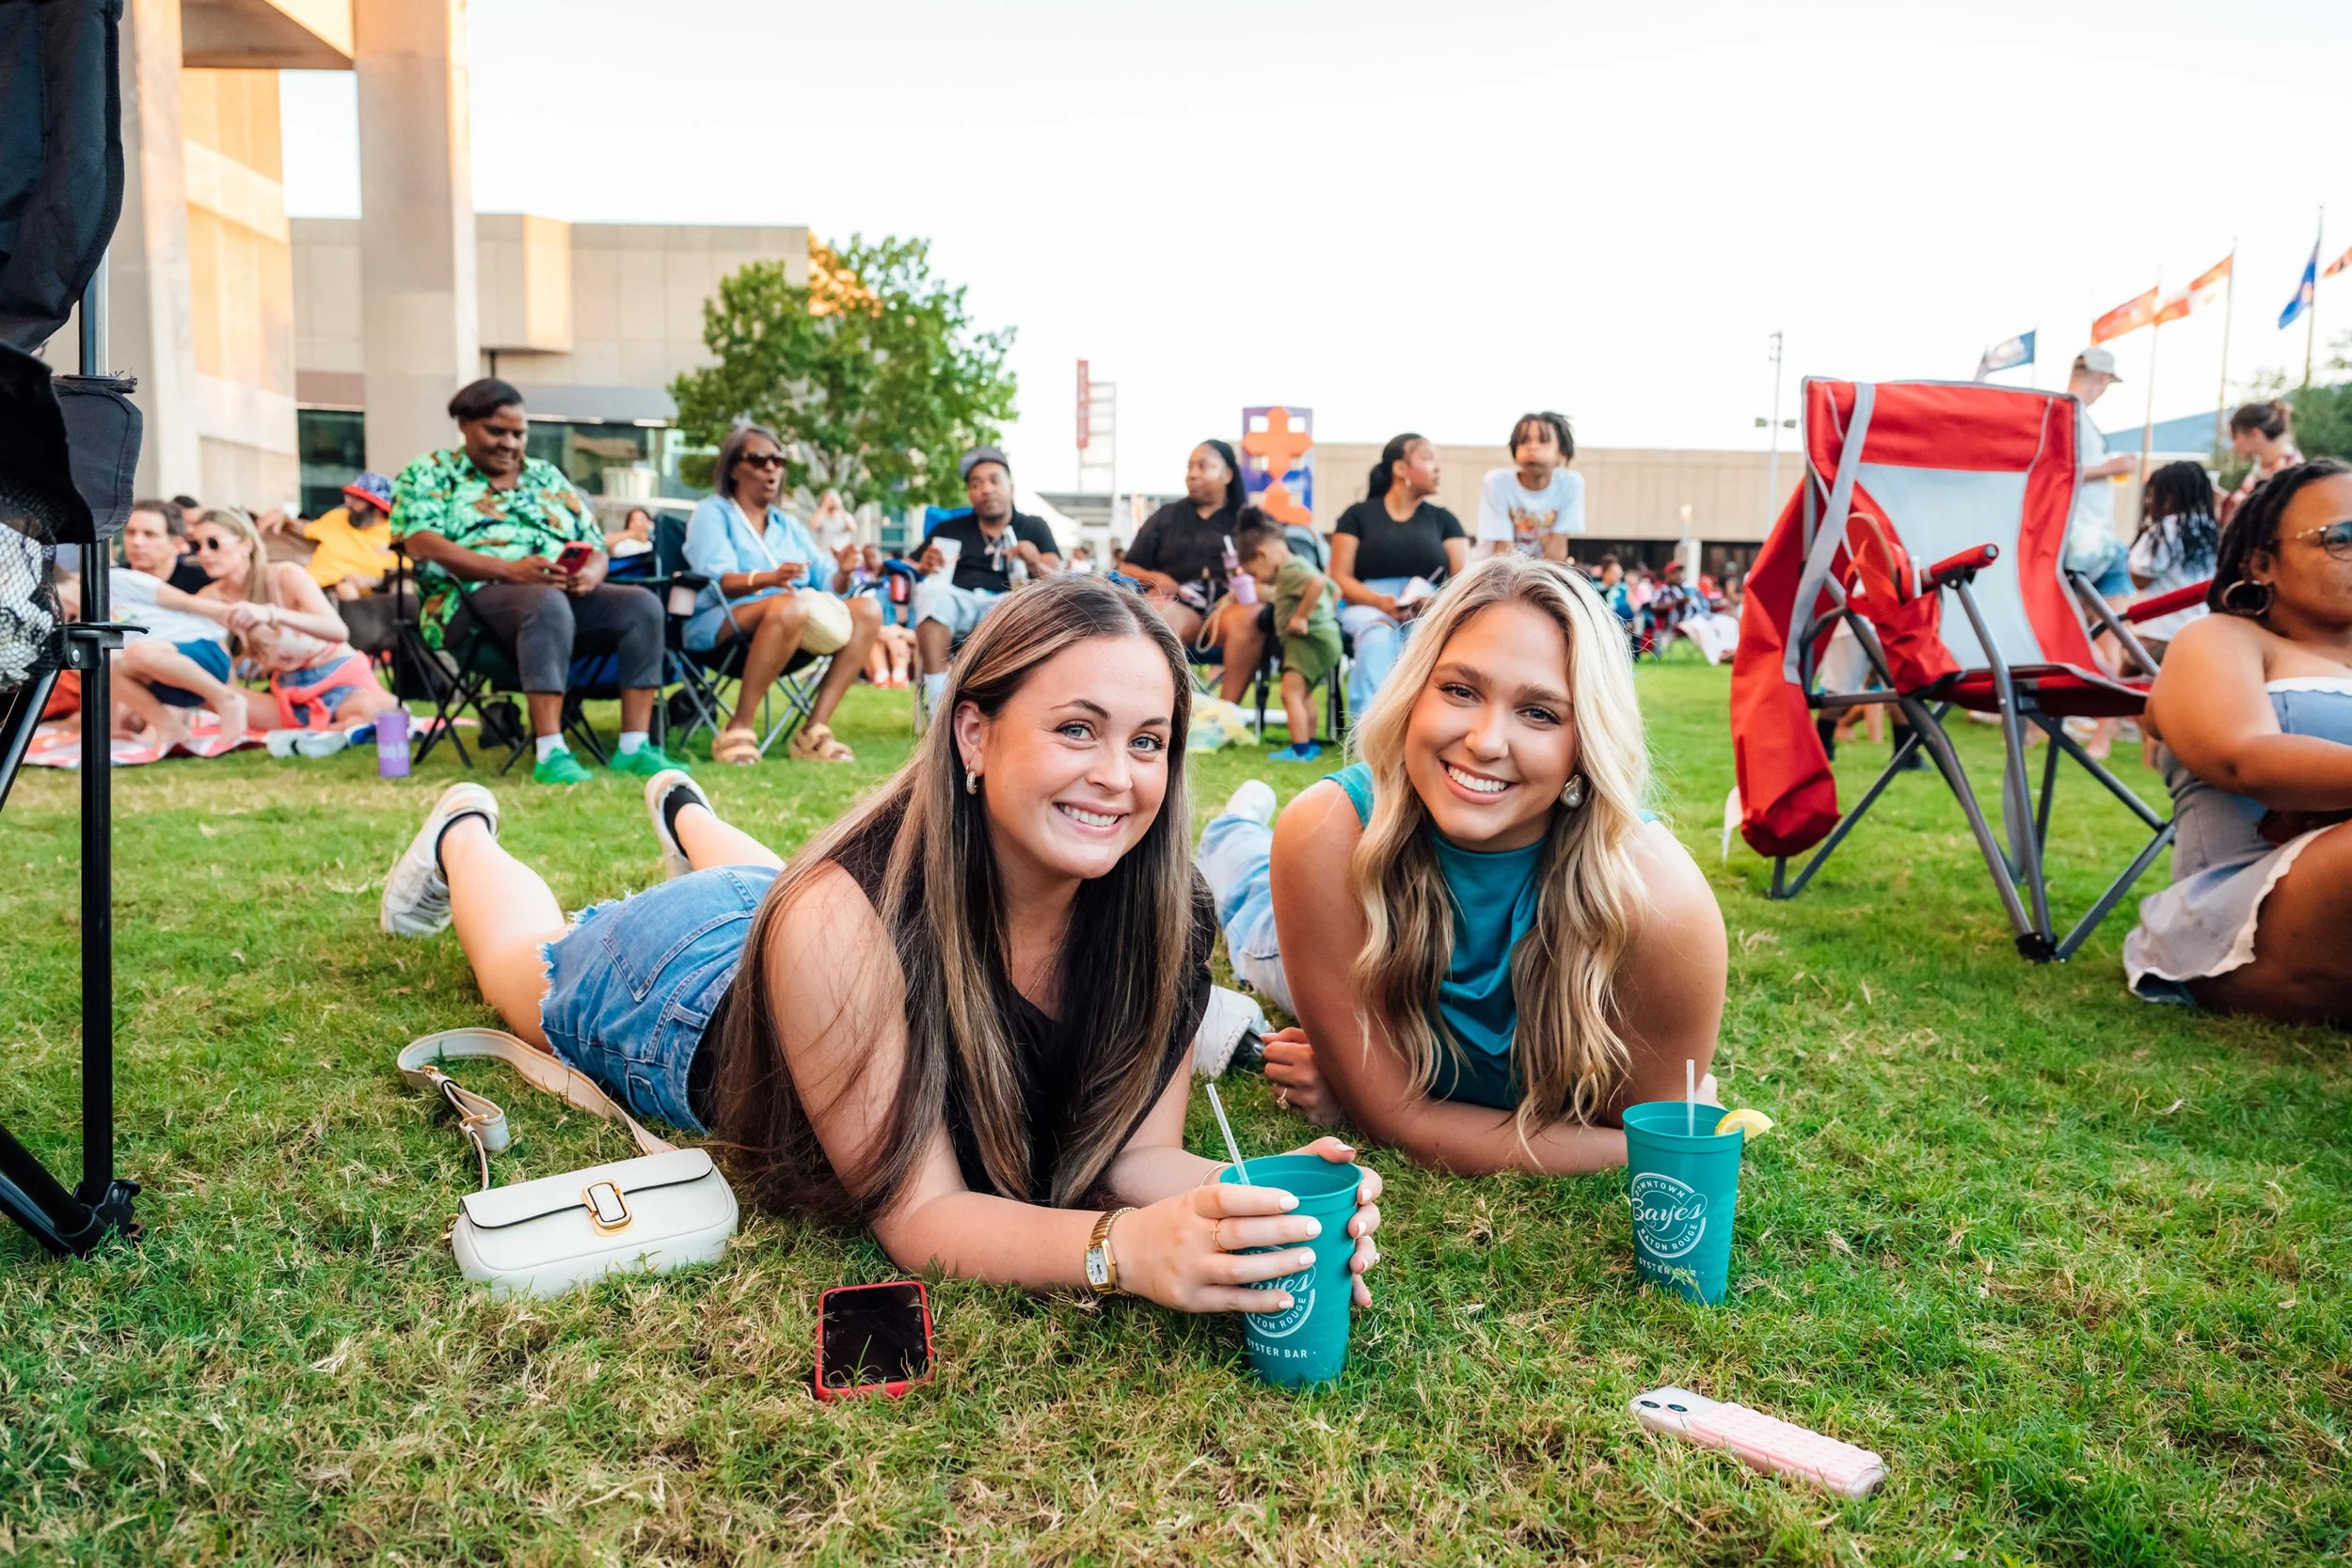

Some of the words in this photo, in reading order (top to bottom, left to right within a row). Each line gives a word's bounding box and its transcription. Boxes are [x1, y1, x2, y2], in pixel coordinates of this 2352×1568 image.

[1634, 1180, 1686, 1197] DOWNTOWN
[1631, 1197, 1708, 1232] Bayes
[1640, 1227, 1668, 1251] BATON
[1671, 1224, 1698, 1251] ROUGE
[1249, 1312, 1276, 1330] ATON
[1279, 1297, 1307, 1328] ROUGE
[1247, 1338, 1279, 1356] OYSTER
[1284, 1349, 1308, 1358] BAR
